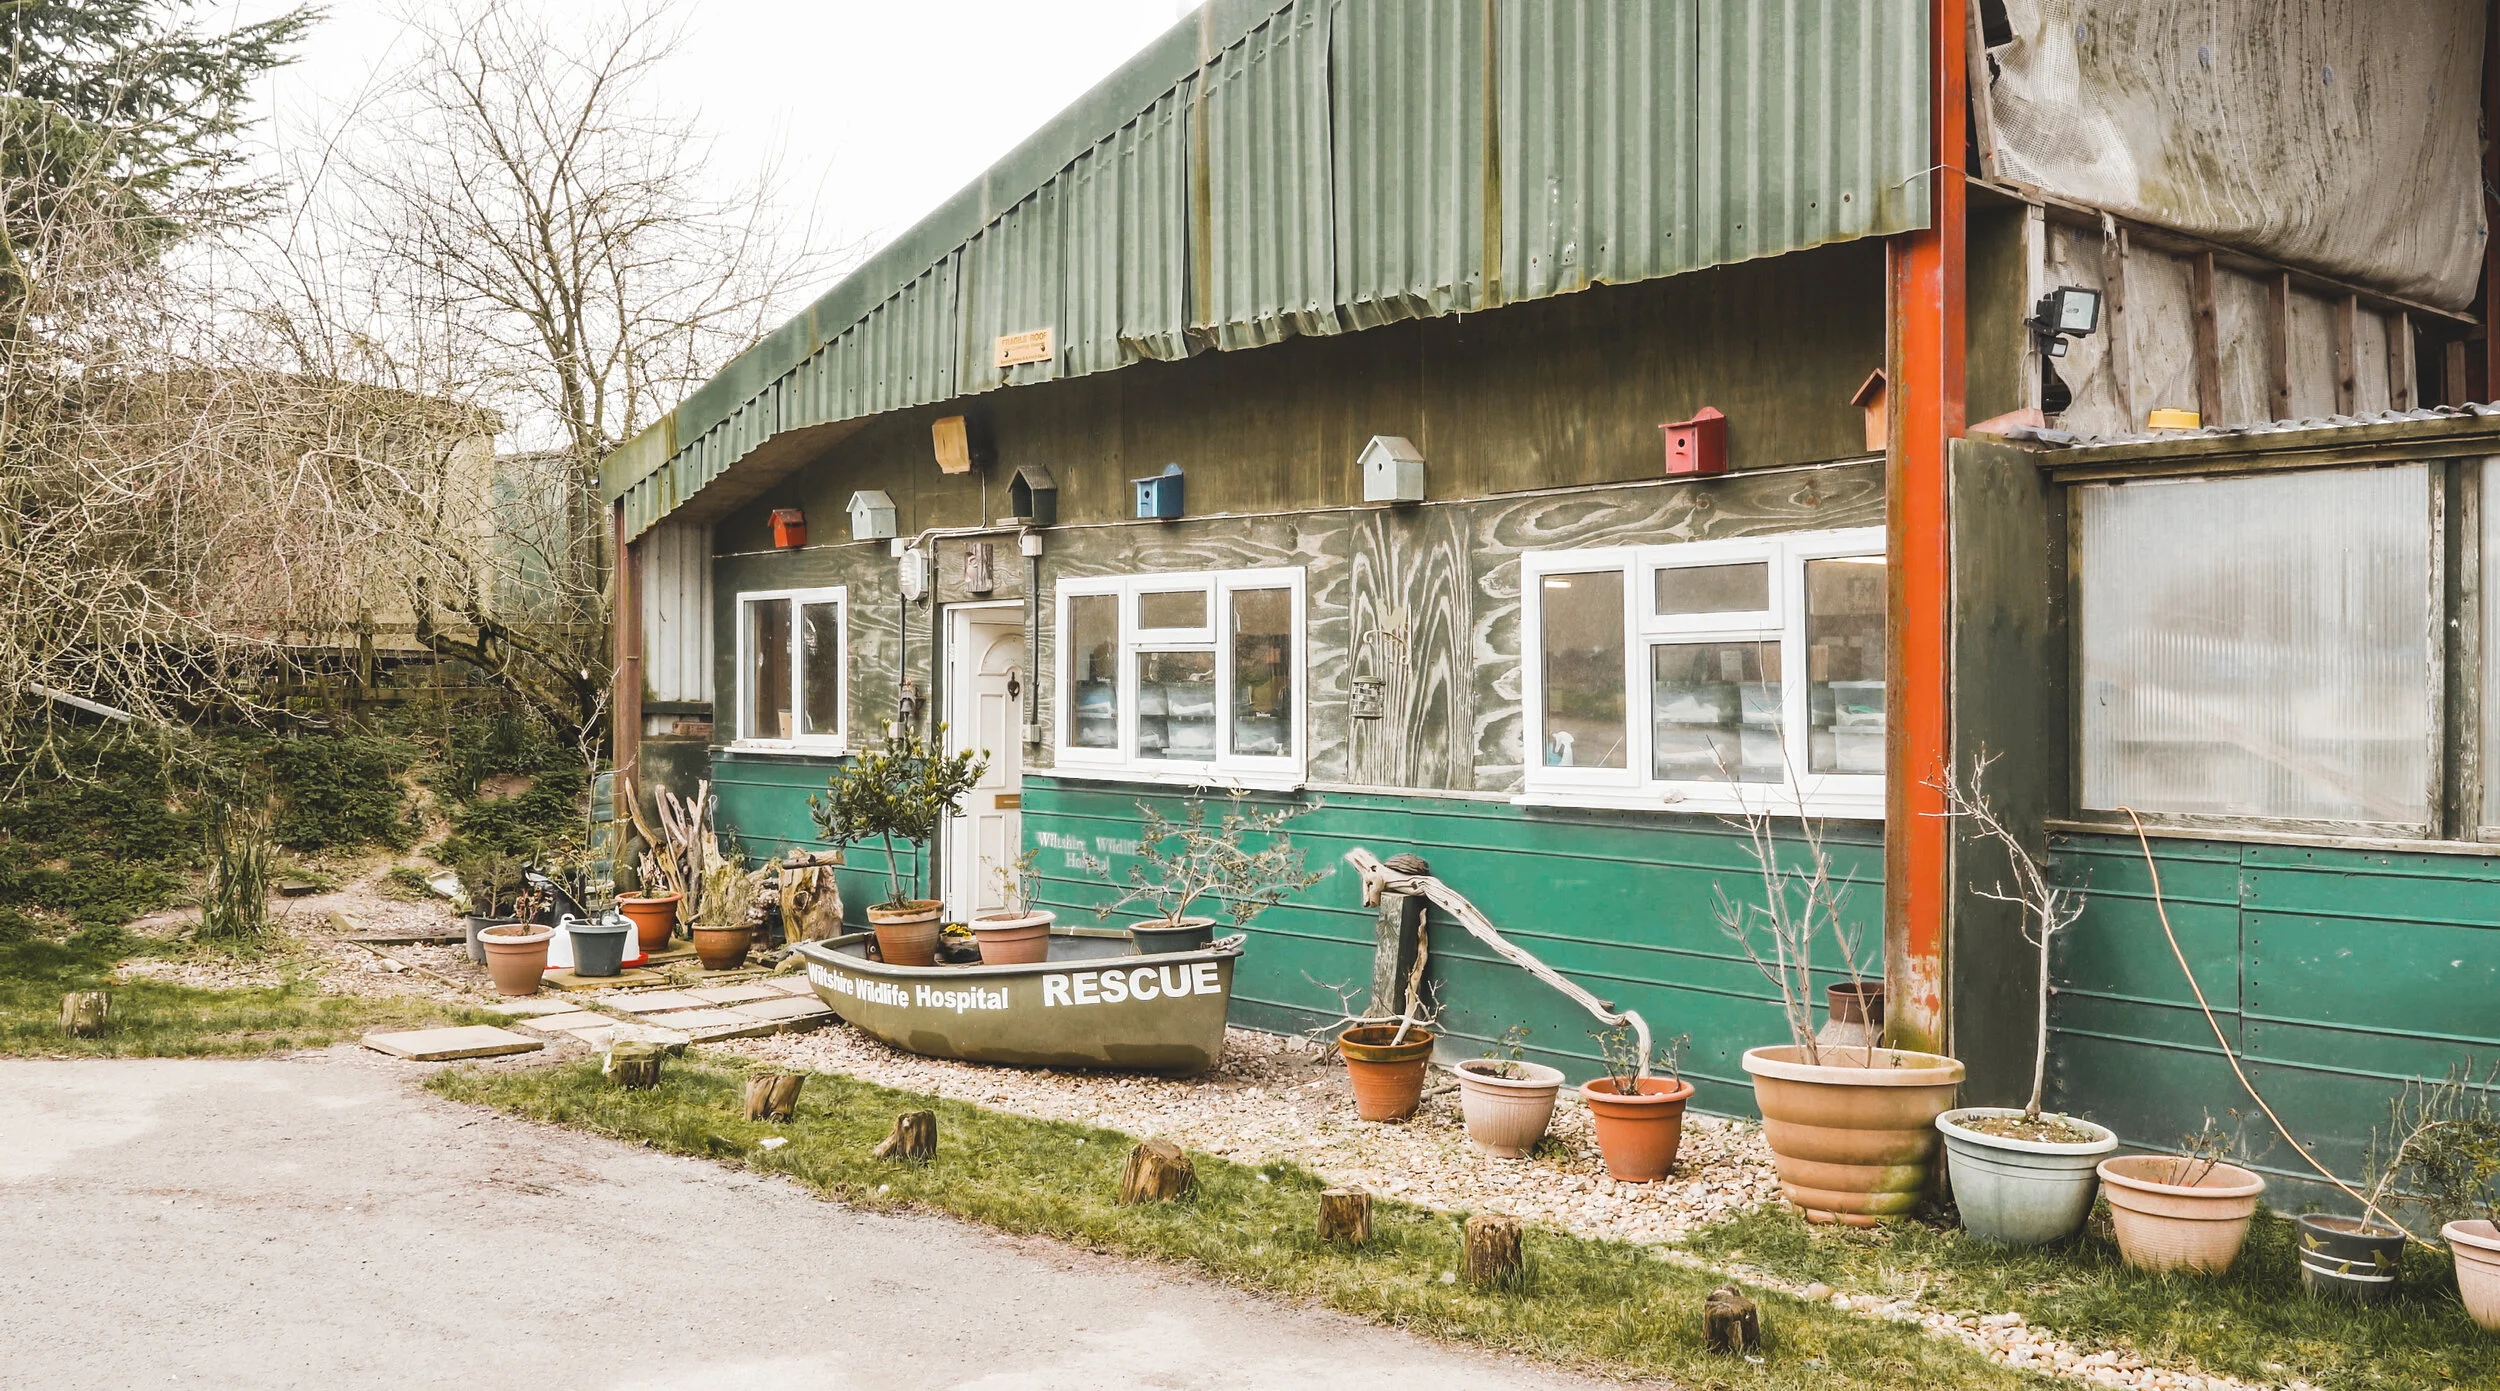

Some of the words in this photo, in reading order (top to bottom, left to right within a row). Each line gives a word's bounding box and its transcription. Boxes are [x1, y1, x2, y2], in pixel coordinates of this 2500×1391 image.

[1030, 331, 1047, 340] ROOF
[1096, 836, 1138, 857] Wildlif
[1064, 852, 1110, 875] Hospal
[808, 962, 854, 995] Wiltshire
[856, 978, 910, 1008] Wildlife
[916, 984, 1009, 1013] Hospital
[1042, 962, 1221, 1007] RESCUE
